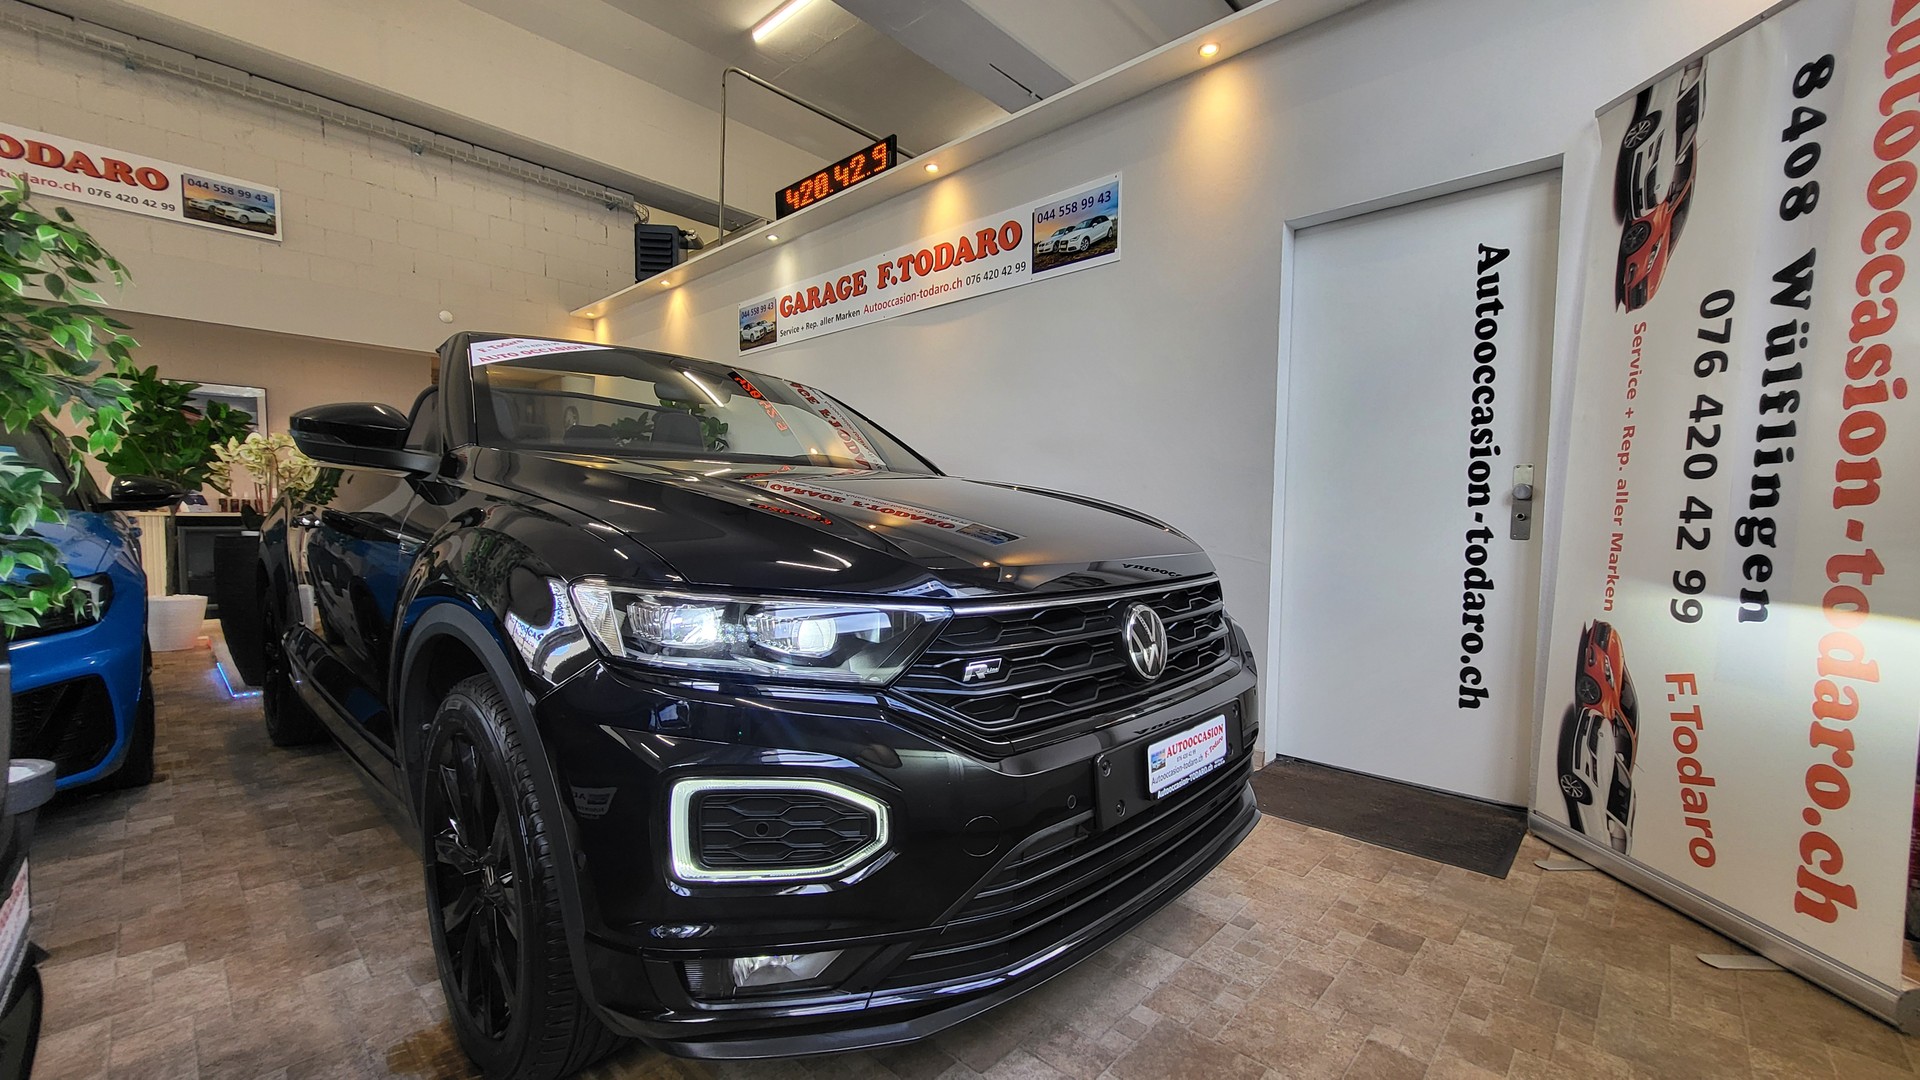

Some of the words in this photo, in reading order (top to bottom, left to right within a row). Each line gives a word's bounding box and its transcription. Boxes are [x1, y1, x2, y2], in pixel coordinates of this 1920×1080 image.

[1779, 54, 1835, 221] 8408
[87, 187, 112, 199] 076
[115, 193, 139, 205] 420
[142, 199, 158, 209] 42
[160, 202, 176, 212] 99
[187, 178, 209, 189] 044
[213, 183, 235, 196] 558
[237, 189, 252, 199] 99
[254, 194, 268, 203] 43
[1037, 208, 1056, 224] 044
[1058, 201, 1078, 217] 558
[1081, 196, 1095, 210] 99
[1097, 190, 1112, 205] 43
[779, 270, 868, 318] GARAGE
[877, 220, 1023, 290] F.TODARO
[780, 325, 800, 338] Service
[805, 320, 819, 331] Rep.
[820, 315, 834, 326] aller
[835, 309, 861, 322] Marken
[863, 276, 963, 315] Autooccasion-todaro.ch
[965, 273, 982, 286] 076
[983, 268, 1000, 281] 420
[1001, 264, 1013, 277] 42
[1015, 260, 1027, 272] 99
[750, 306, 760, 317] 558
[760, 304, 767, 314] 99
[767, 301, 774, 311] 43
[1693, 289, 1736, 379] 076
[479, 351, 519, 363] AUTO
[1626, 321, 1648, 400] Service
[1624, 407, 1635, 418] +
[1683, 394, 1724, 481] 420
[1734, 247, 1817, 624] Wülfingen
[1457, 242, 1511, 710] Autooccasion-todaro.ch
[1616, 424, 1636, 472] Rep.
[1794, 0, 1920, 924] utooccasion-todaro.ch
[1610, 478, 1627, 527] aller
[1676, 496, 1713, 551] 42
[1603, 532, 1623, 612] Marken
[1669, 569, 1707, 624] 99
[1166, 723, 1224, 758] AUTOOCCASION
[1665, 672, 1717, 868] F.Todaro
